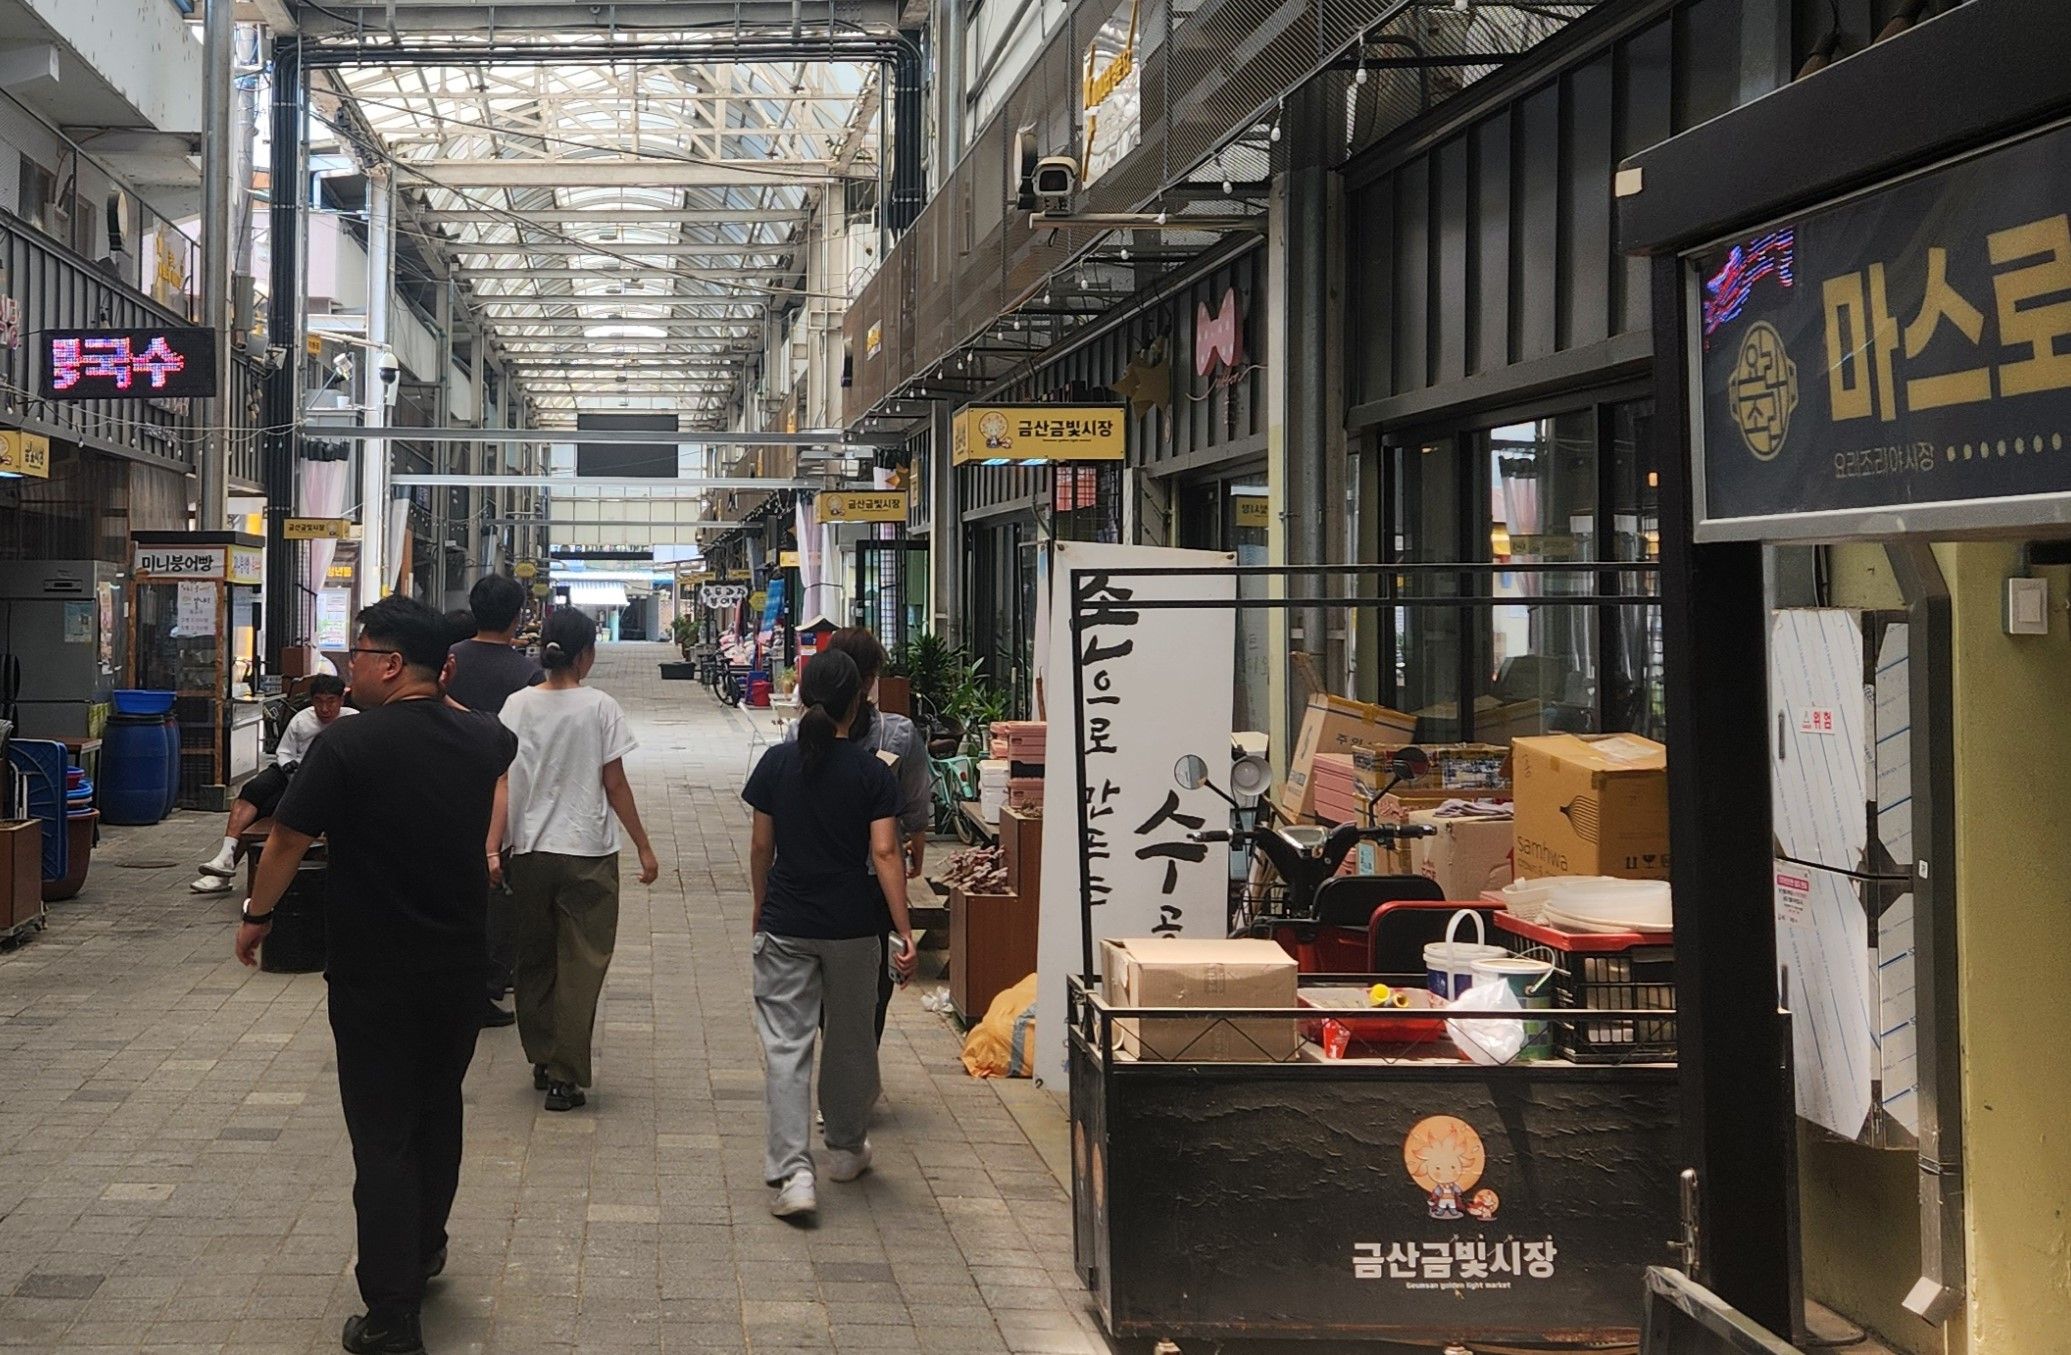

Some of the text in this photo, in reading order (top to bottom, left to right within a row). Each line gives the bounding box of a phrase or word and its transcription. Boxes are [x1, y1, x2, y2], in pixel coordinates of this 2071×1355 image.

[1018, 419, 1113, 437] 금산금빛시장
[1834, 442, 1934, 479] 요리조리야시장
[848, 499, 900, 509] 금산금빛시장
[142, 554, 214, 572] 미니붕어빵
[1517, 836, 1568, 872] samhwa
[1352, 1239, 1558, 1279] 금산금빛시장
[1466, 1282, 1484, 1290] light
[1485, 1282, 1511, 1290] market
